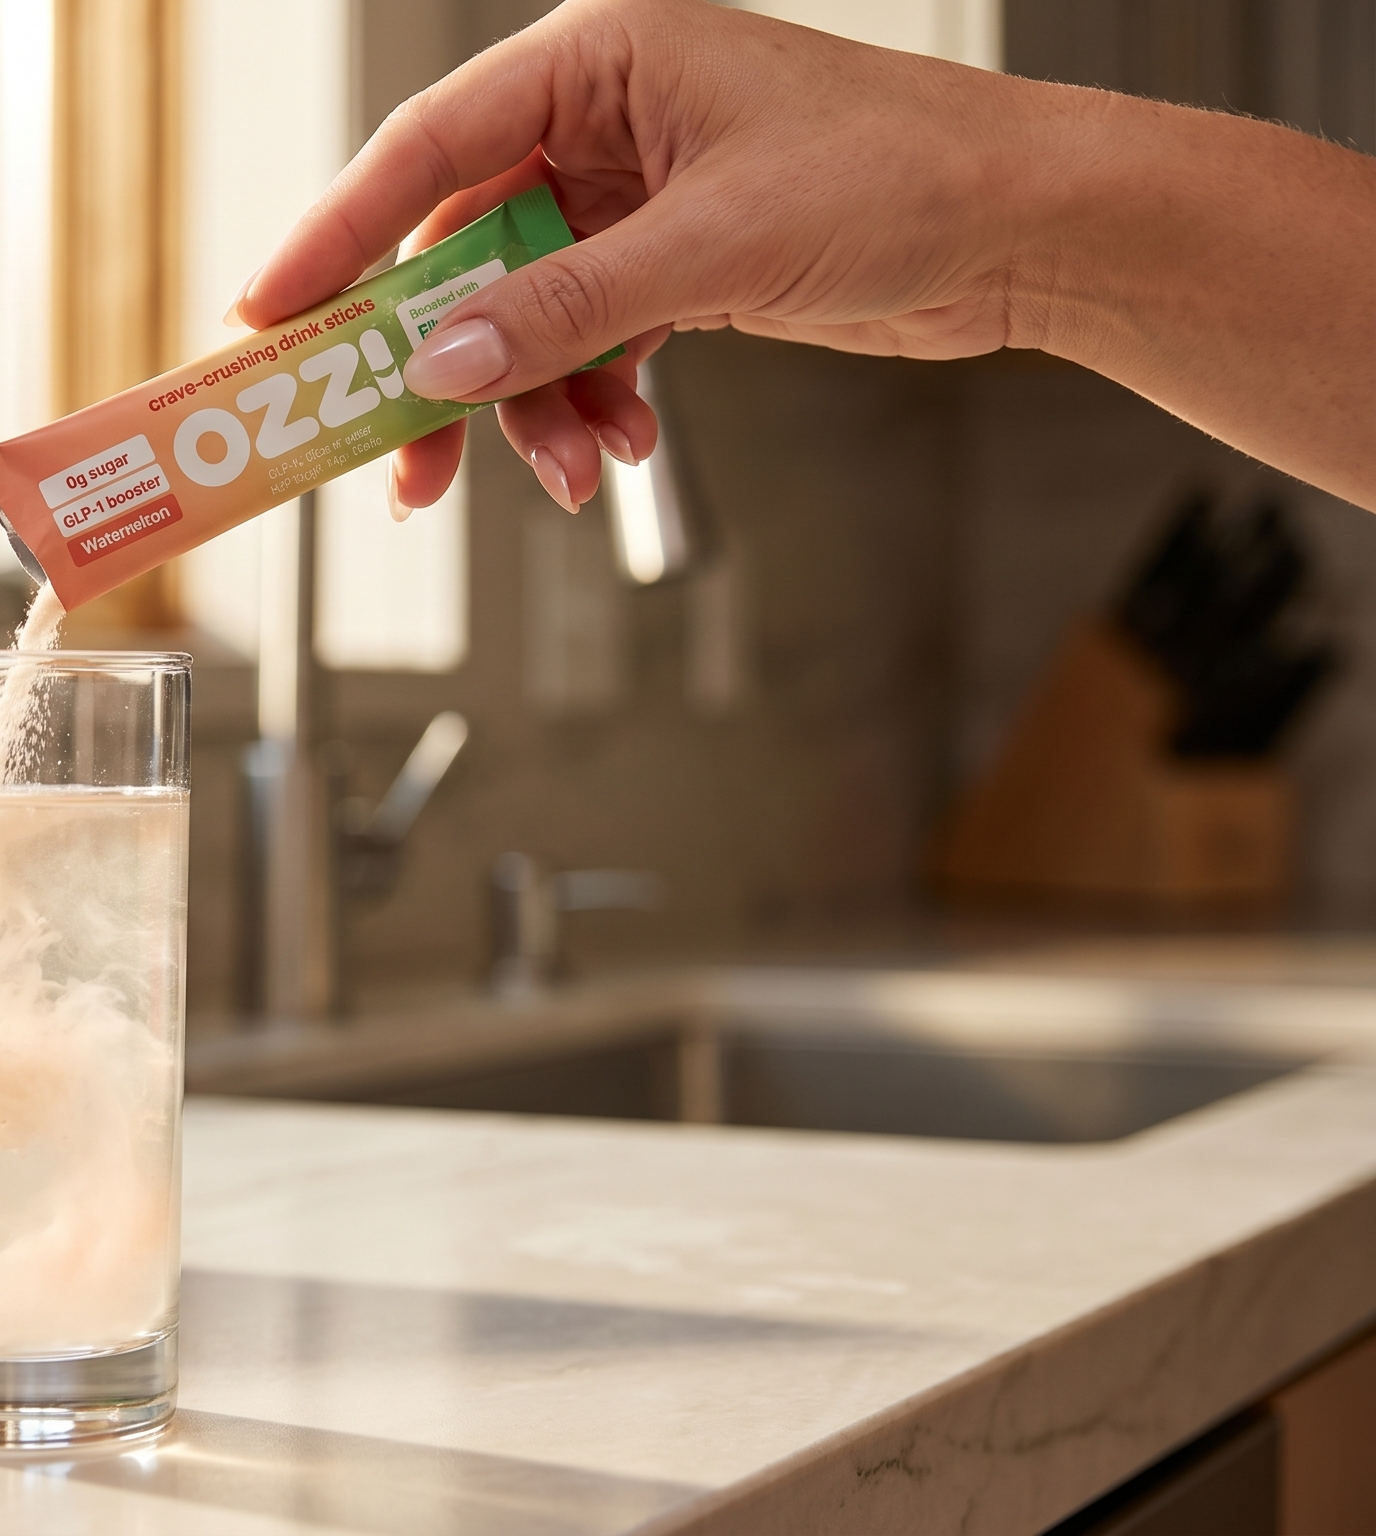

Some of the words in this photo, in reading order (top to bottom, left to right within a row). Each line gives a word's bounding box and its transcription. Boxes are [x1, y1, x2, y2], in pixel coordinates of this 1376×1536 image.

[148, 344, 279, 413] crave-crushing
[277, 321, 324, 352] drink
[323, 298, 377, 331] sticks
[65, 473, 89, 490] 0g
[88, 453, 130, 481] sugar
[62, 500, 106, 529] GLP-1
[105, 475, 162, 510] booster
